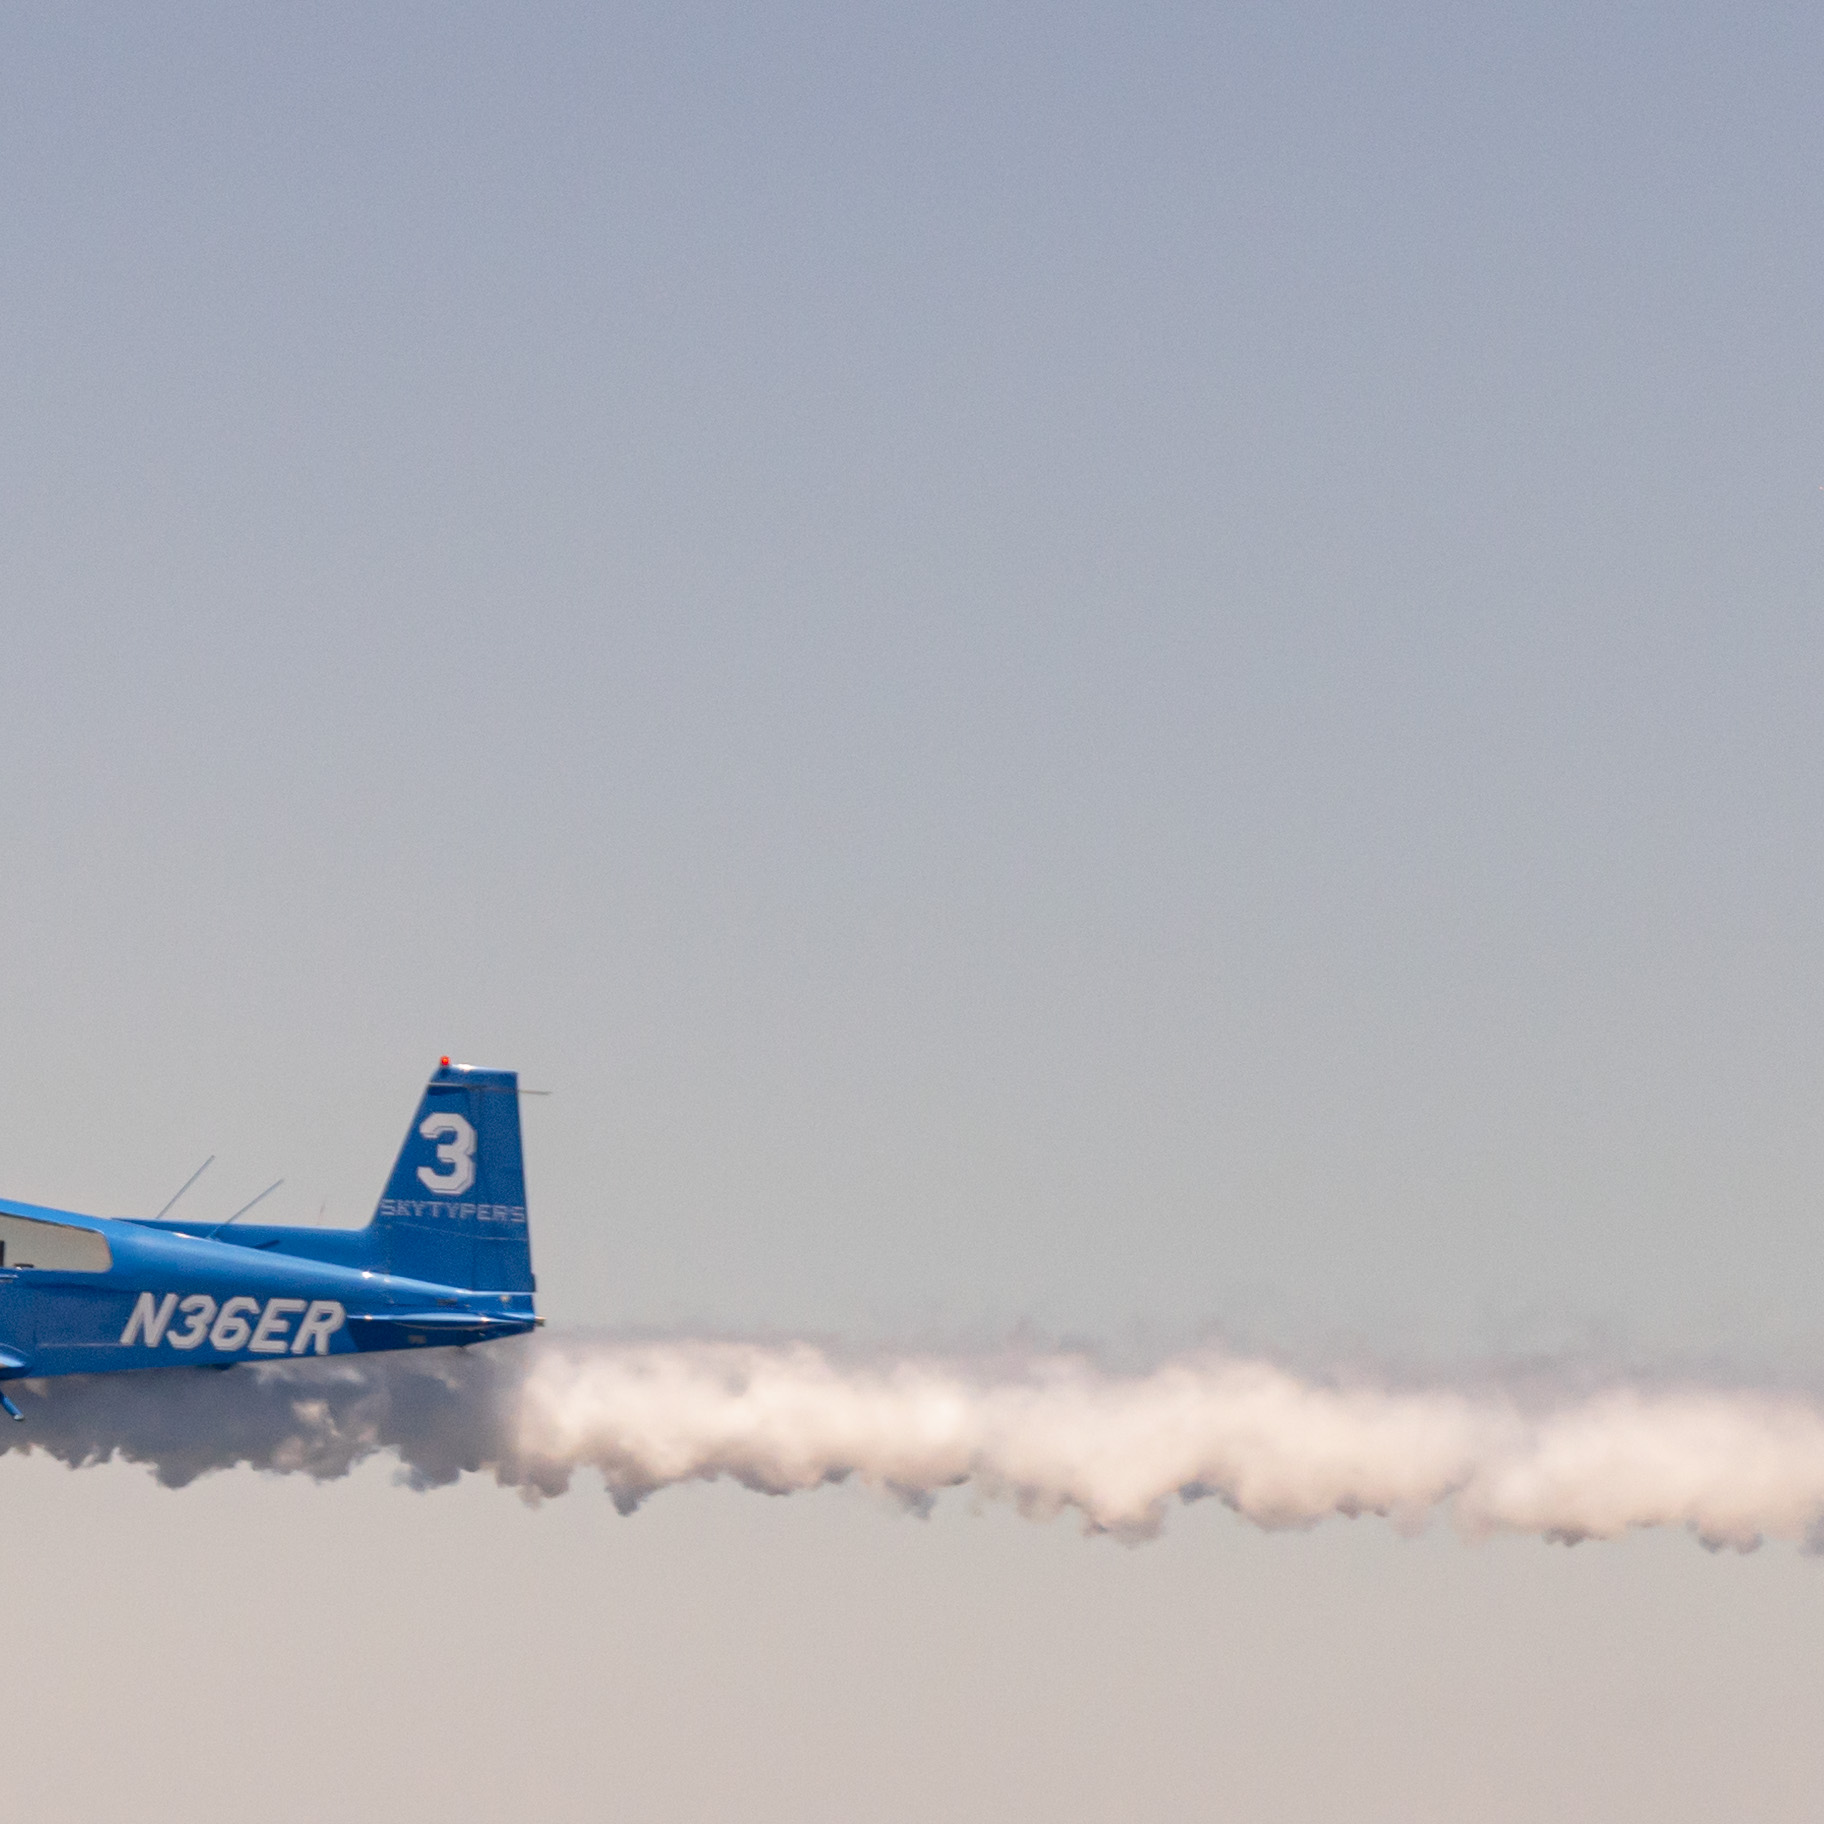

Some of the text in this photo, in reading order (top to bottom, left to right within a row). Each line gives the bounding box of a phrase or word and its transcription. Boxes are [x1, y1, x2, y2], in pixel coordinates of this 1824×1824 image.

[417, 1112, 476, 1195] 3
[379, 1199, 526, 1222] SKYTYPERS
[119, 1292, 347, 1355] N36ER
